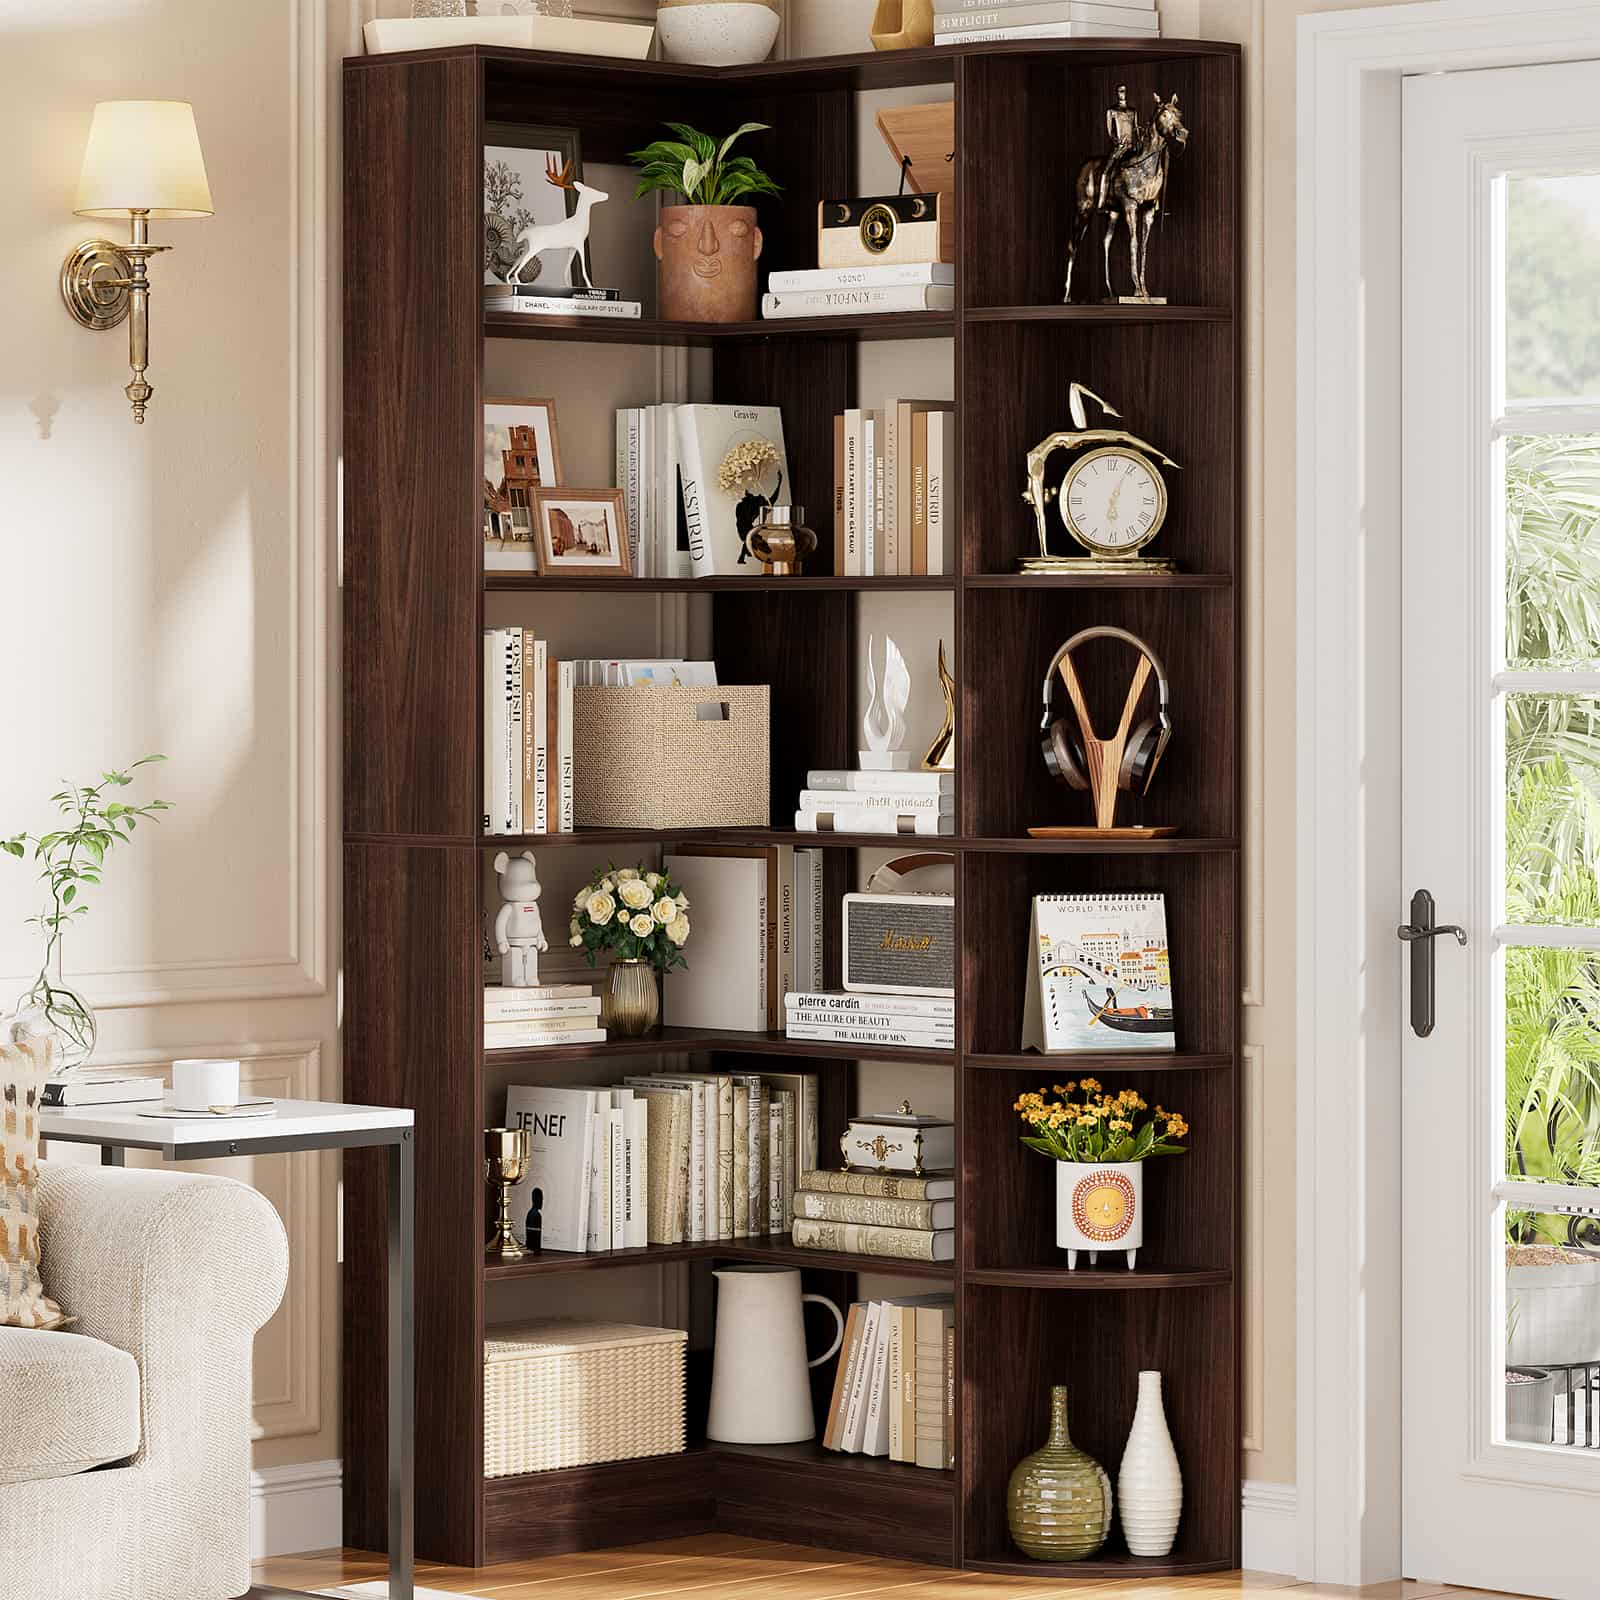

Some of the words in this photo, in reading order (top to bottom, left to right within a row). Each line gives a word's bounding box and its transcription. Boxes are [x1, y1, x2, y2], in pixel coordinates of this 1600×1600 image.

[941, 14, 998, 28] SIMPLICITY
[524, 302, 550, 310] CHANEL
[825, 291, 870, 305] KINFOLK
[733, 409, 759, 422] Gravity
[914, 466, 922, 525] PHILADELPHIA
[929, 474, 939, 525] ASTRID
[683, 478, 705, 561] ASTRID
[513, 634, 521, 680] LOST
[513, 684, 521, 722] FISH
[537, 747, 545, 782] FISH
[563, 755, 572, 788] FISH
[537, 786, 545, 830] LOST
[563, 790, 572, 830] LOST
[759, 896, 766, 907] To
[814, 862, 822, 920] AFTERWORD
[759, 908, 766, 920] Be
[1058, 904, 1094, 913] WORLD
[1098, 903, 1147, 913] TRAVELER
[814, 924, 822, 935] BY
[814, 940, 822, 976] DEEPAK
[798, 995, 826, 1008] pierre
[829, 996, 860, 1009] cardin
[795, 1011, 813, 1023] THE
[813, 1012, 845, 1024] ALLURE
[846, 1014, 857, 1025] OF
[858, 1015, 892, 1027] BEAUTY
[834, 1031, 849, 1039] THE
[849, 1031, 878, 1041] ALLURE
[879, 1033, 889, 1041] OF
[889, 1033, 906, 1042] MEN
[891, 1341, 899, 1392] IMMUNITY
